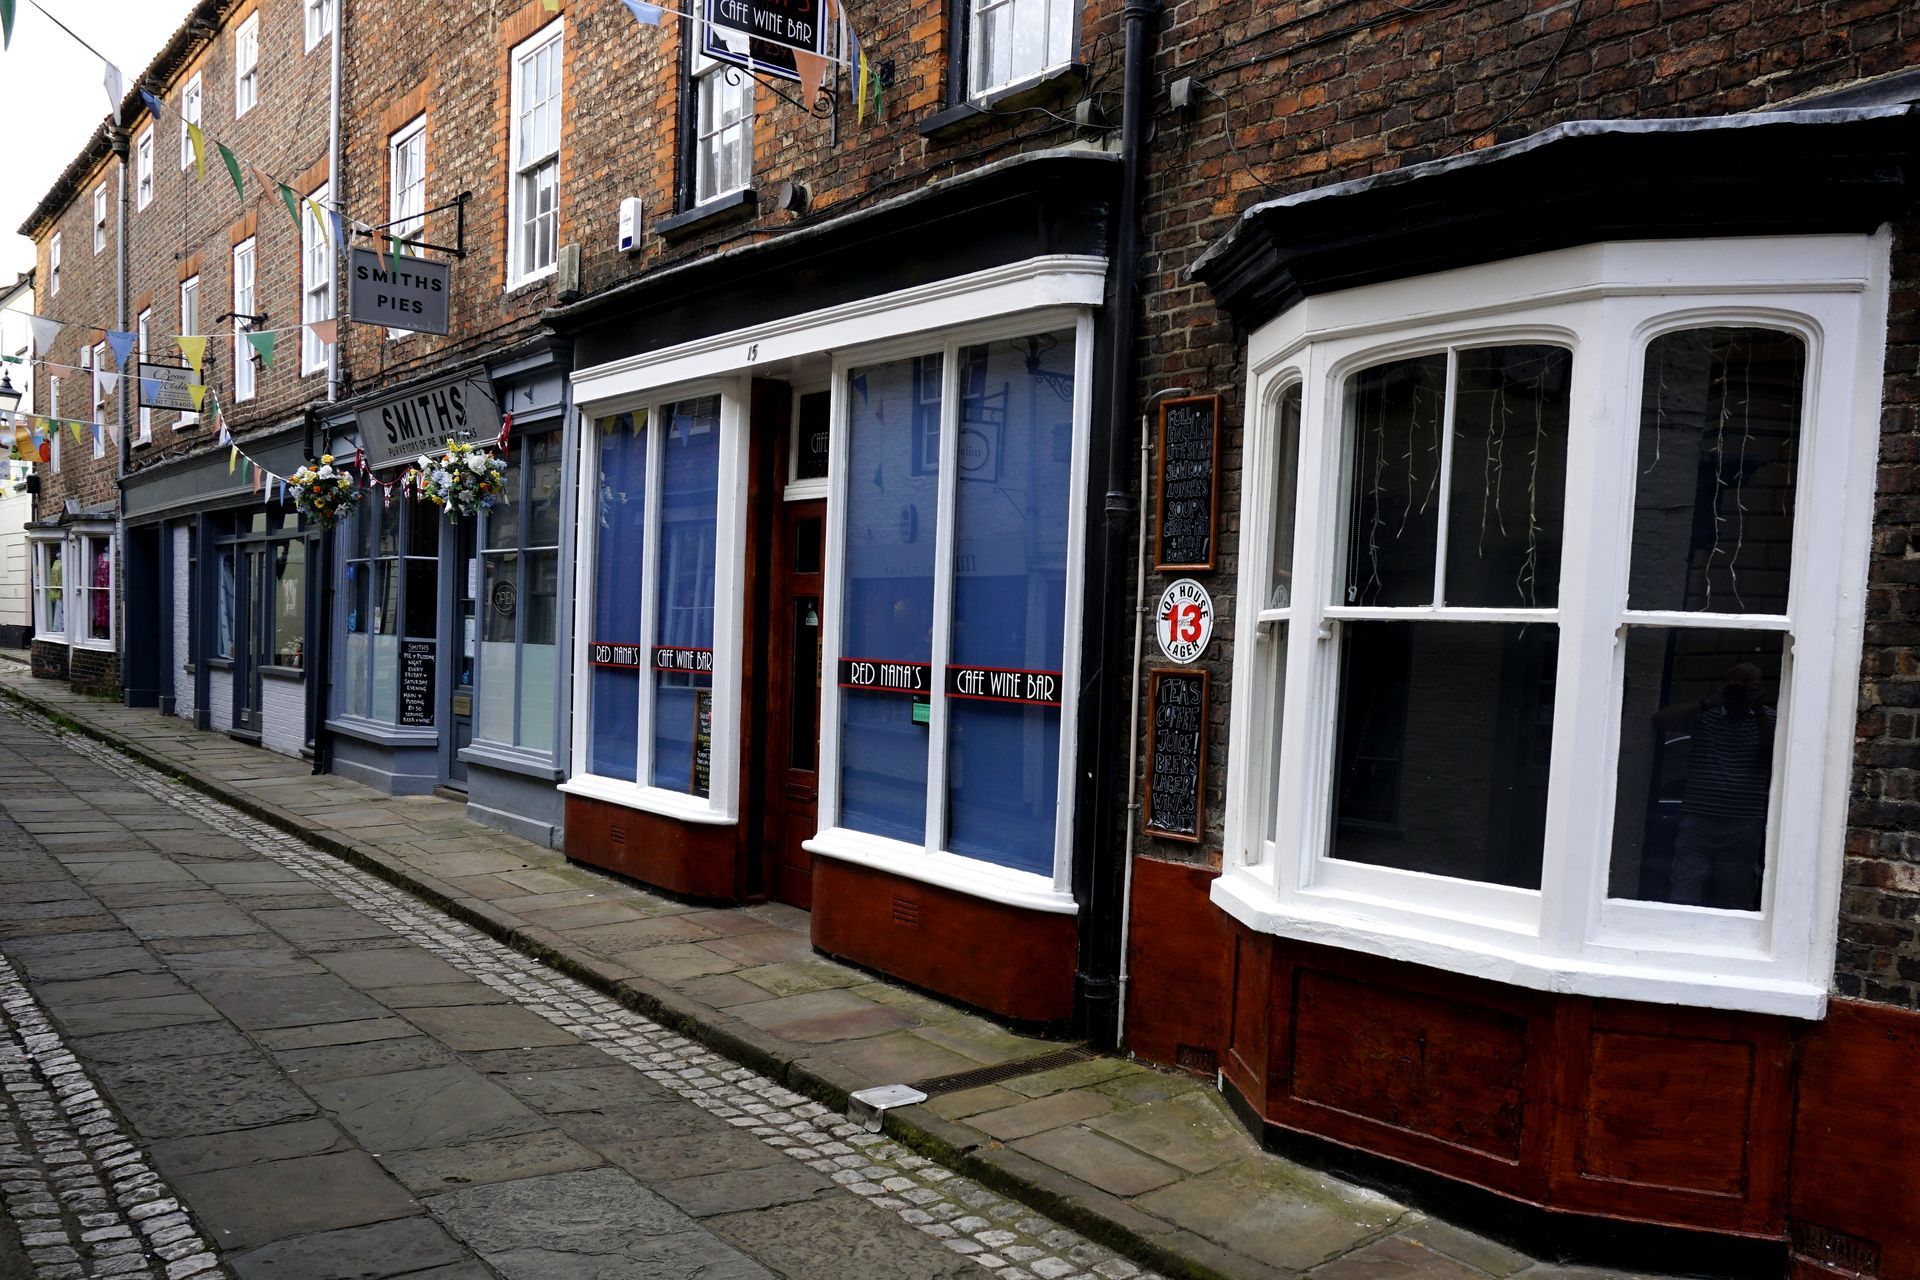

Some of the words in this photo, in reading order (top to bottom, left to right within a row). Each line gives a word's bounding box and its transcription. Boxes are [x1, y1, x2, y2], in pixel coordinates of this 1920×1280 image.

[720, 0, 749, 24] CAFE
[753, 7, 783, 35] WINE
[787, 18, 812, 44] BAR
[357, 266, 442, 292] SMITHS
[378, 294, 423, 314] PIES
[747, 344, 758, 361] 15
[382, 386, 467, 444] SMITHS
[811, 431, 829, 453] CAFE
[1161, 592, 1175, 621] HOP
[1179, 585, 1209, 620] HOUSE
[1167, 604, 1202, 642] 13
[596, 645, 611, 663] RED
[613, 646, 638, 665] NANA'S
[657, 649, 674, 668] CAFE
[676, 650, 694, 669] WINE
[697, 651, 712, 671] BAR
[1167, 640, 1200, 658] LAGER
[851, 662, 876, 685] RED
[880, 664, 922, 690] NANA'S
[957, 670, 985, 695] CAFE
[990, 671, 1021, 698] WINE
[1026, 674, 1055, 701] BAR
[1161, 678, 1201, 705] TEAS
[1156, 704, 1200, 731] COFFEE
[1155, 753, 1198, 775] BEERS
